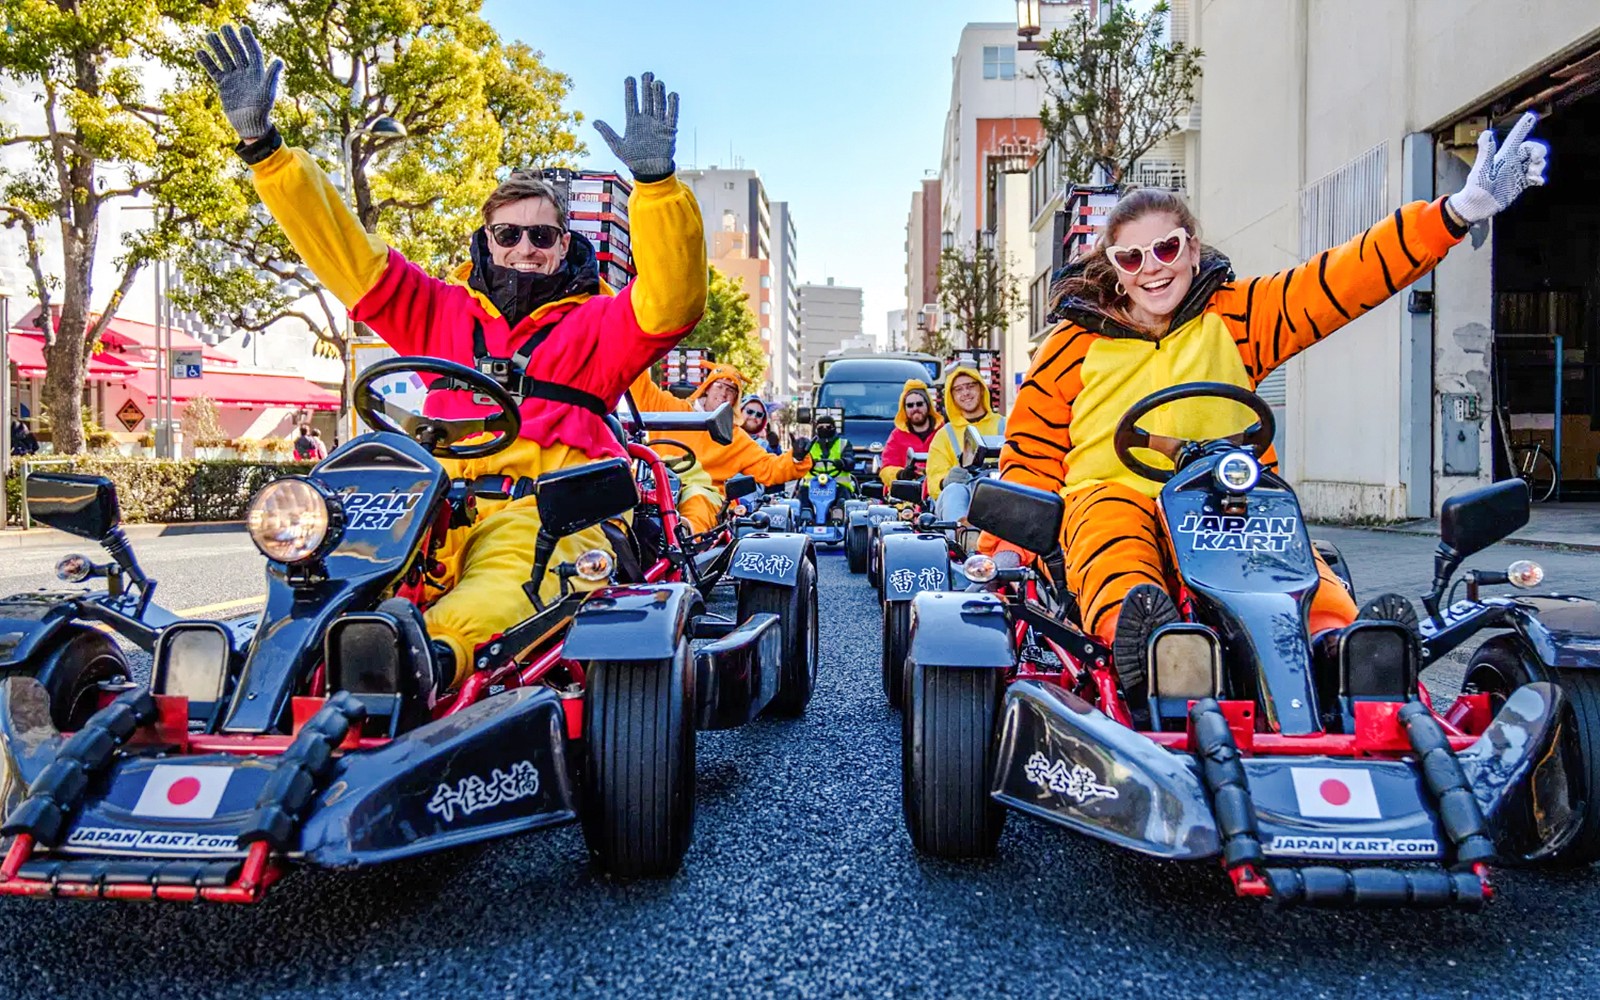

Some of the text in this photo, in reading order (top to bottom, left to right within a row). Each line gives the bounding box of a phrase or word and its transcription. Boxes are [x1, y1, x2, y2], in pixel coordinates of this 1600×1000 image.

[337, 493, 424, 512] PAN
[1177, 515, 1297, 535] JAPAN
[1192, 533, 1292, 552] KART
[889, 567, 945, 593] 雷神
[427, 760, 539, 822] 千住大橋
[70, 828, 138, 847] JAPAN
[1273, 837, 1436, 853] JAPAN KART.com
